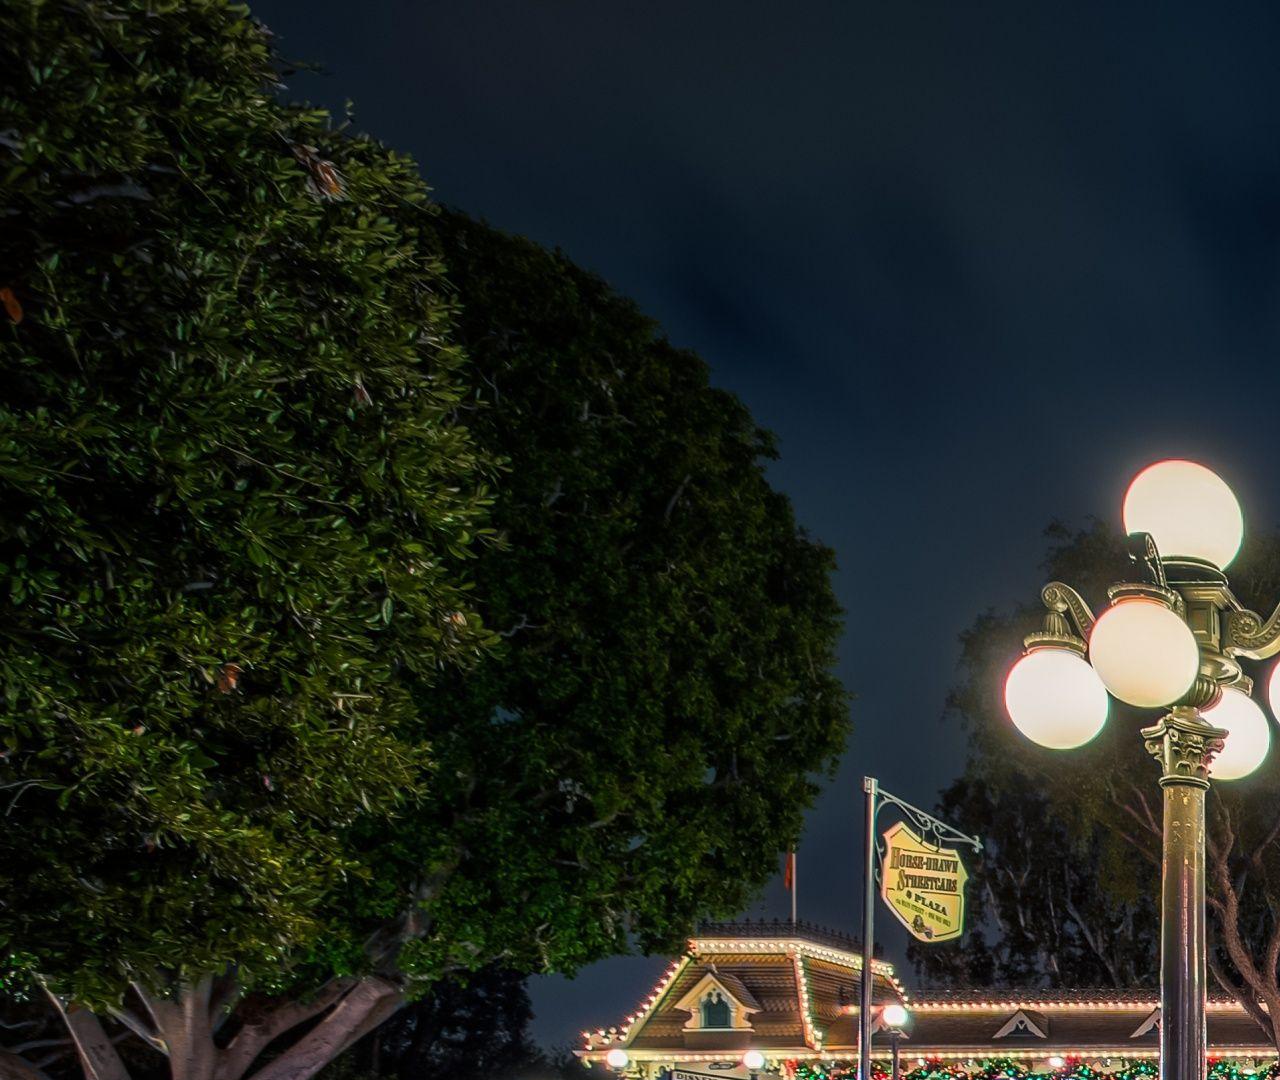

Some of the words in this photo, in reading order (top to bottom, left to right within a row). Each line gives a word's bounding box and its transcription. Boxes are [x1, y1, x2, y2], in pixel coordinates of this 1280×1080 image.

[890, 847, 959, 873] HORSE-DRAWN
[897, 869, 958, 892] STREETCARS
[914, 893, 948, 916] PLAZA
